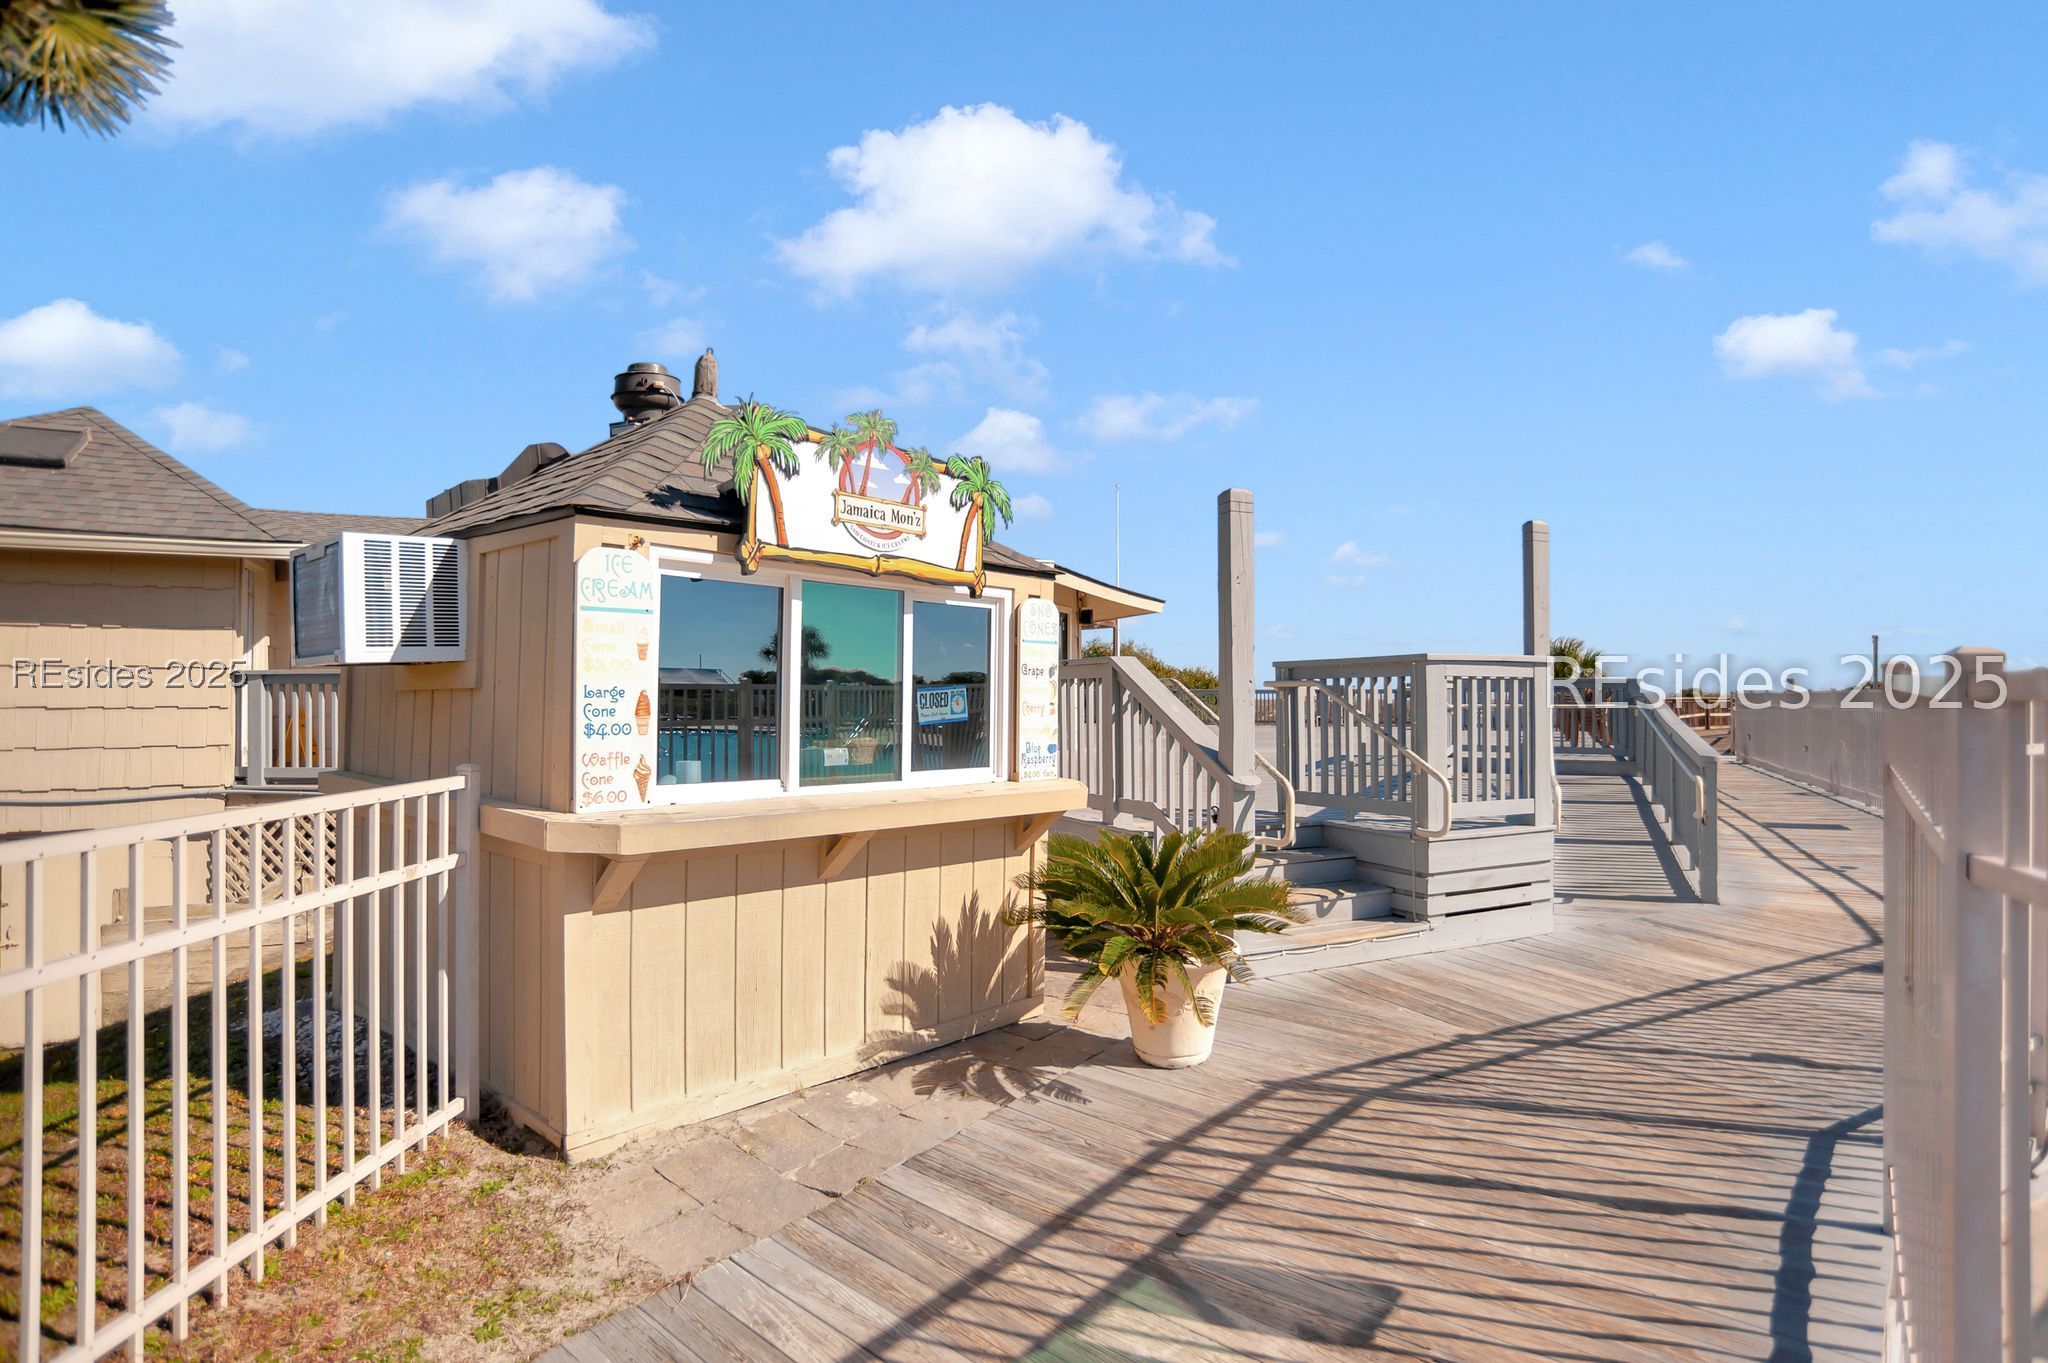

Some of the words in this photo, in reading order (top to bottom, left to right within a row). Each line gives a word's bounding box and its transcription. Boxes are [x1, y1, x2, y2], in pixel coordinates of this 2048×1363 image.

[840, 500, 886, 521] Jamaica
[890, 508, 921, 528] Mon'z
[604, 553, 633, 576] ICE
[581, 577, 653, 603] CREAM
[1021, 663, 1045, 679] Grape
[583, 684, 625, 703] Large
[919, 691, 949, 709] CLOSED
[583, 703, 617, 723] Cone
[583, 722, 632, 740] $4.00
[1025, 742, 1041, 754] Blue
[581, 752, 630, 771] Waffle
[1021, 753, 1056, 768] Raspberry
[581, 771, 614, 789] Cone
